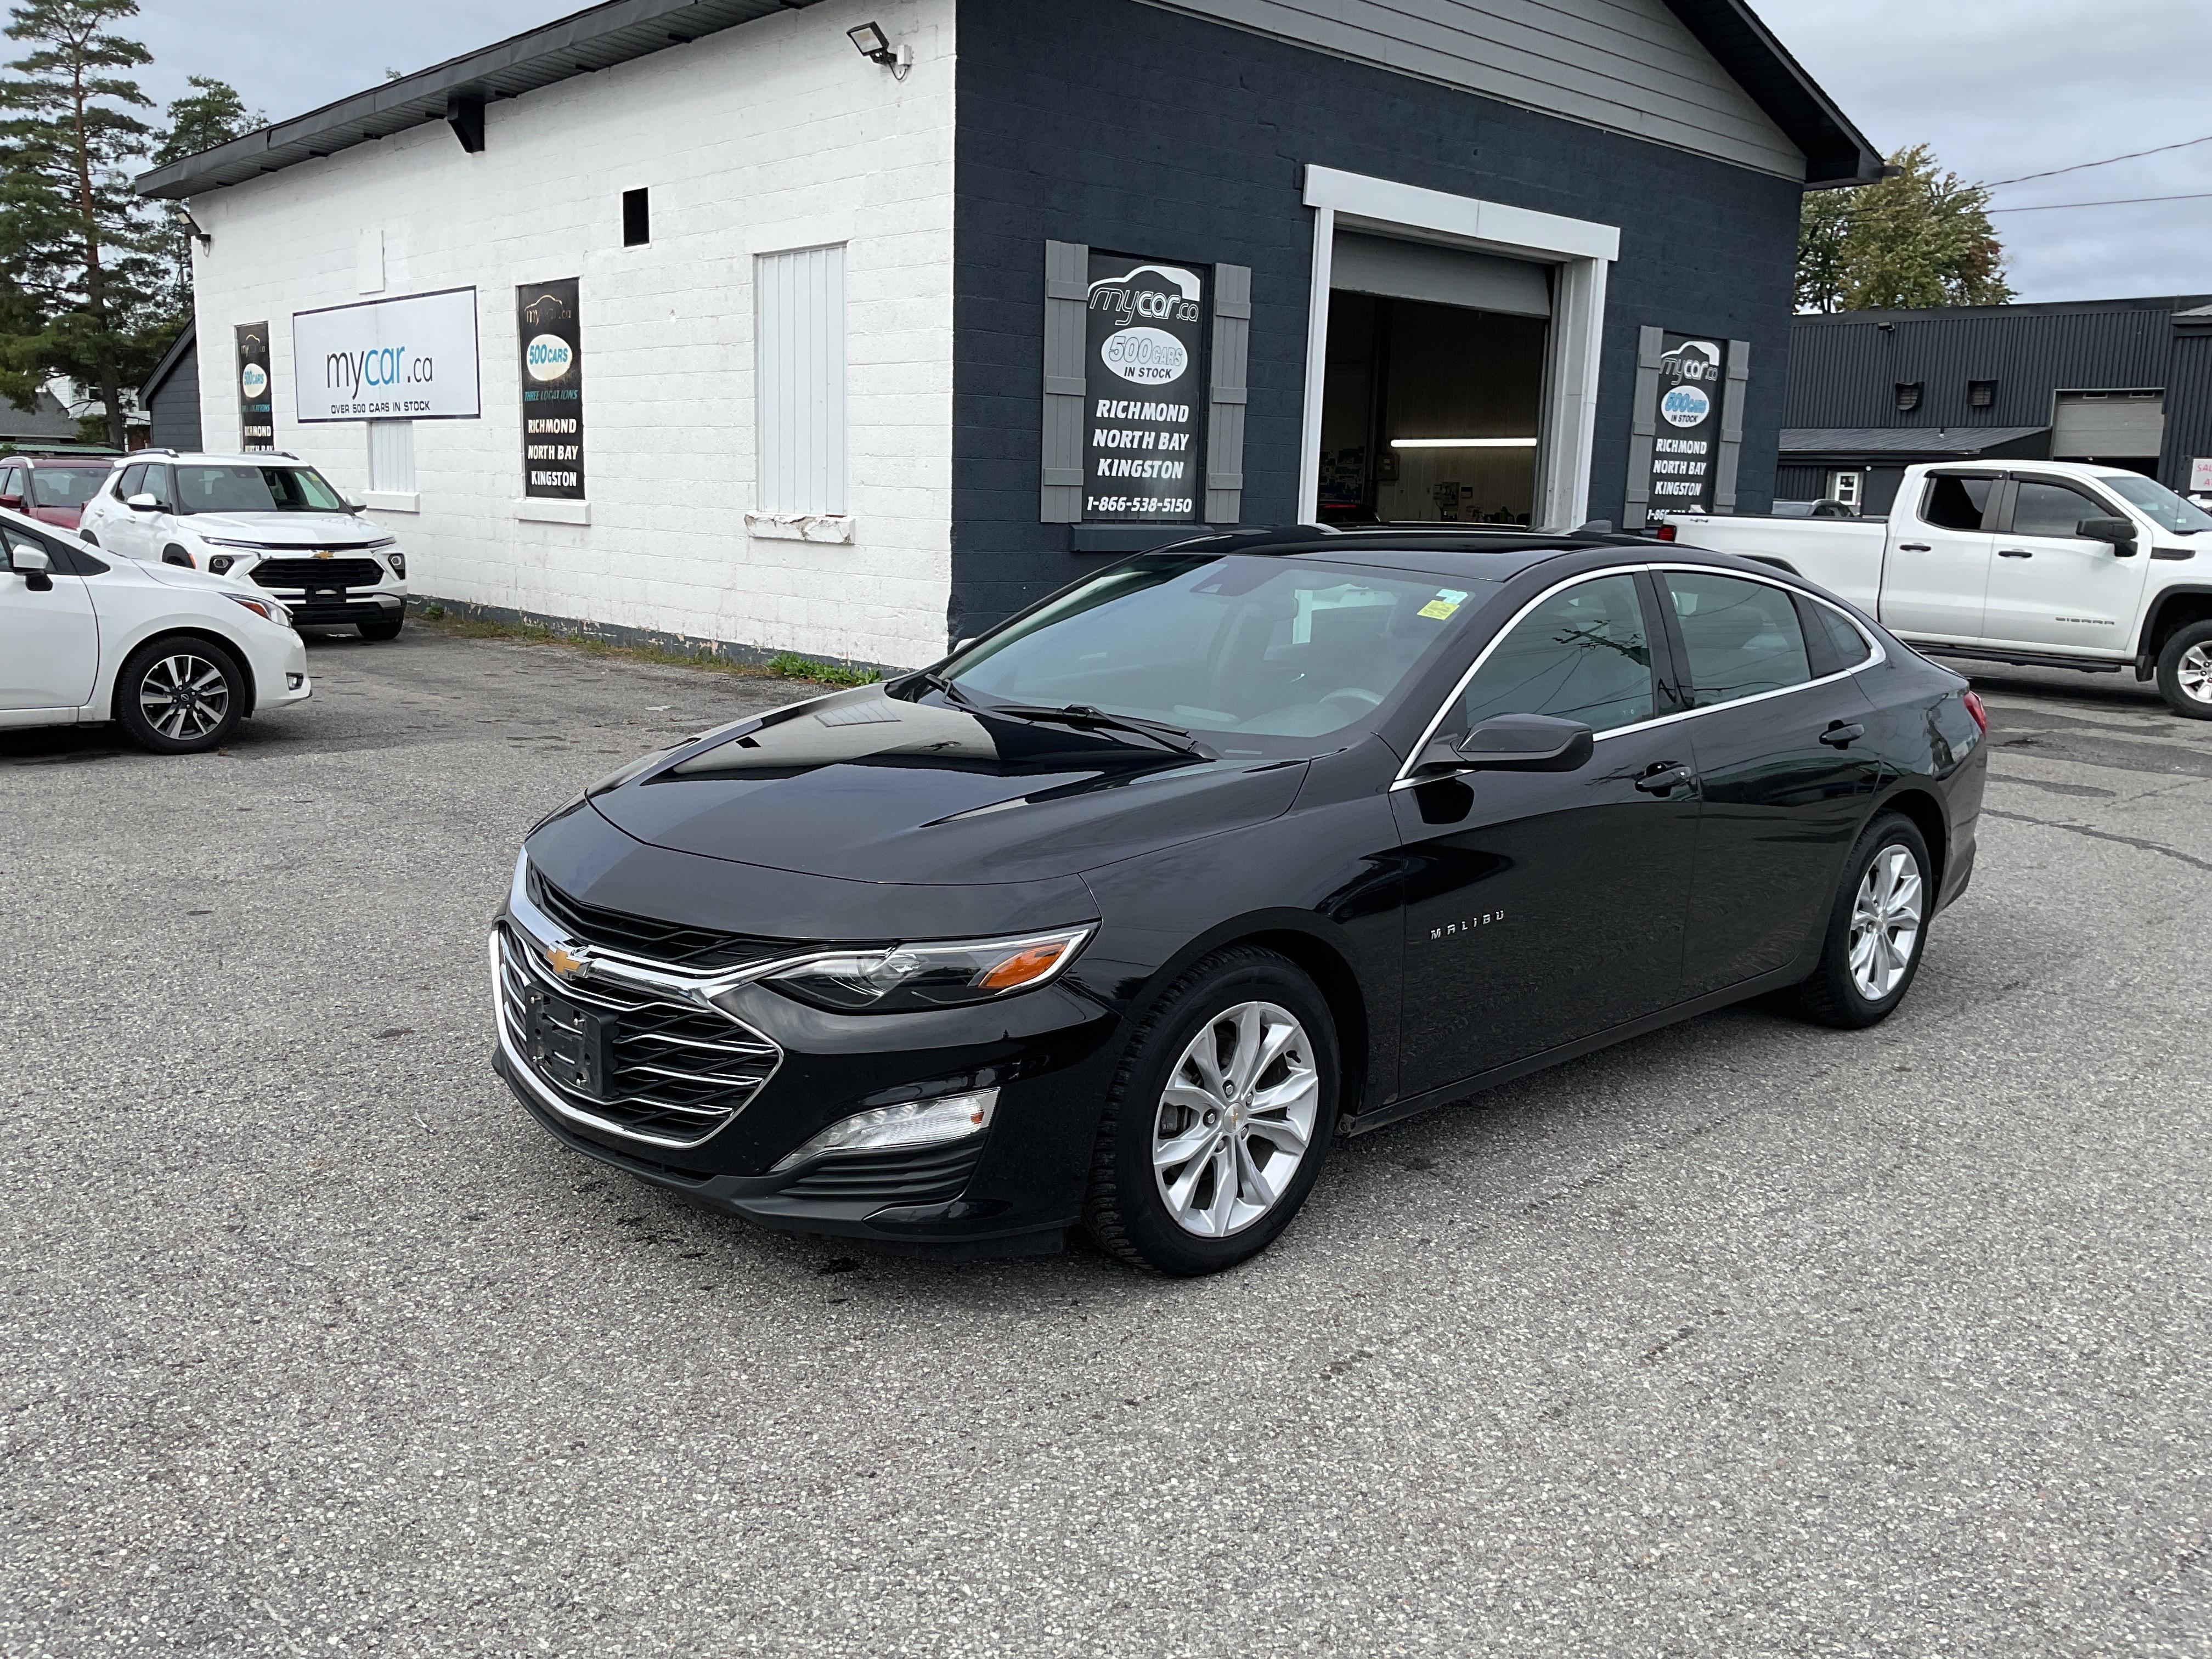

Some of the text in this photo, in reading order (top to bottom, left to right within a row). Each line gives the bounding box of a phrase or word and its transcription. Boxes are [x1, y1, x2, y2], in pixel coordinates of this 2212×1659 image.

[1090, 287, 1199, 325] mycar.ca
[327, 346, 433, 400] mycar.ca
[1124, 366, 1172, 379] IN STOCK
[331, 400, 431, 414] OVER 500 CARS IN STOCK
[1096, 399, 1189, 422] RICHMOND
[528, 419, 577, 433] RICHMOND
[1092, 429, 1189, 450] NORTH BAY
[1656, 438, 1707, 454] RICHMOND
[528, 445, 579, 460] NORTH BAY
[1097, 459, 1184, 478] KINGSTON
[1653, 460, 1707, 475] NORTH BAY
[531, 471, 577, 487] KINGSTON
[1655, 481, 1702, 496] KINGSTON
[1087, 496, 1192, 512] 1-866-538-5150
[1431, 910, 1504, 940] MALIBU
